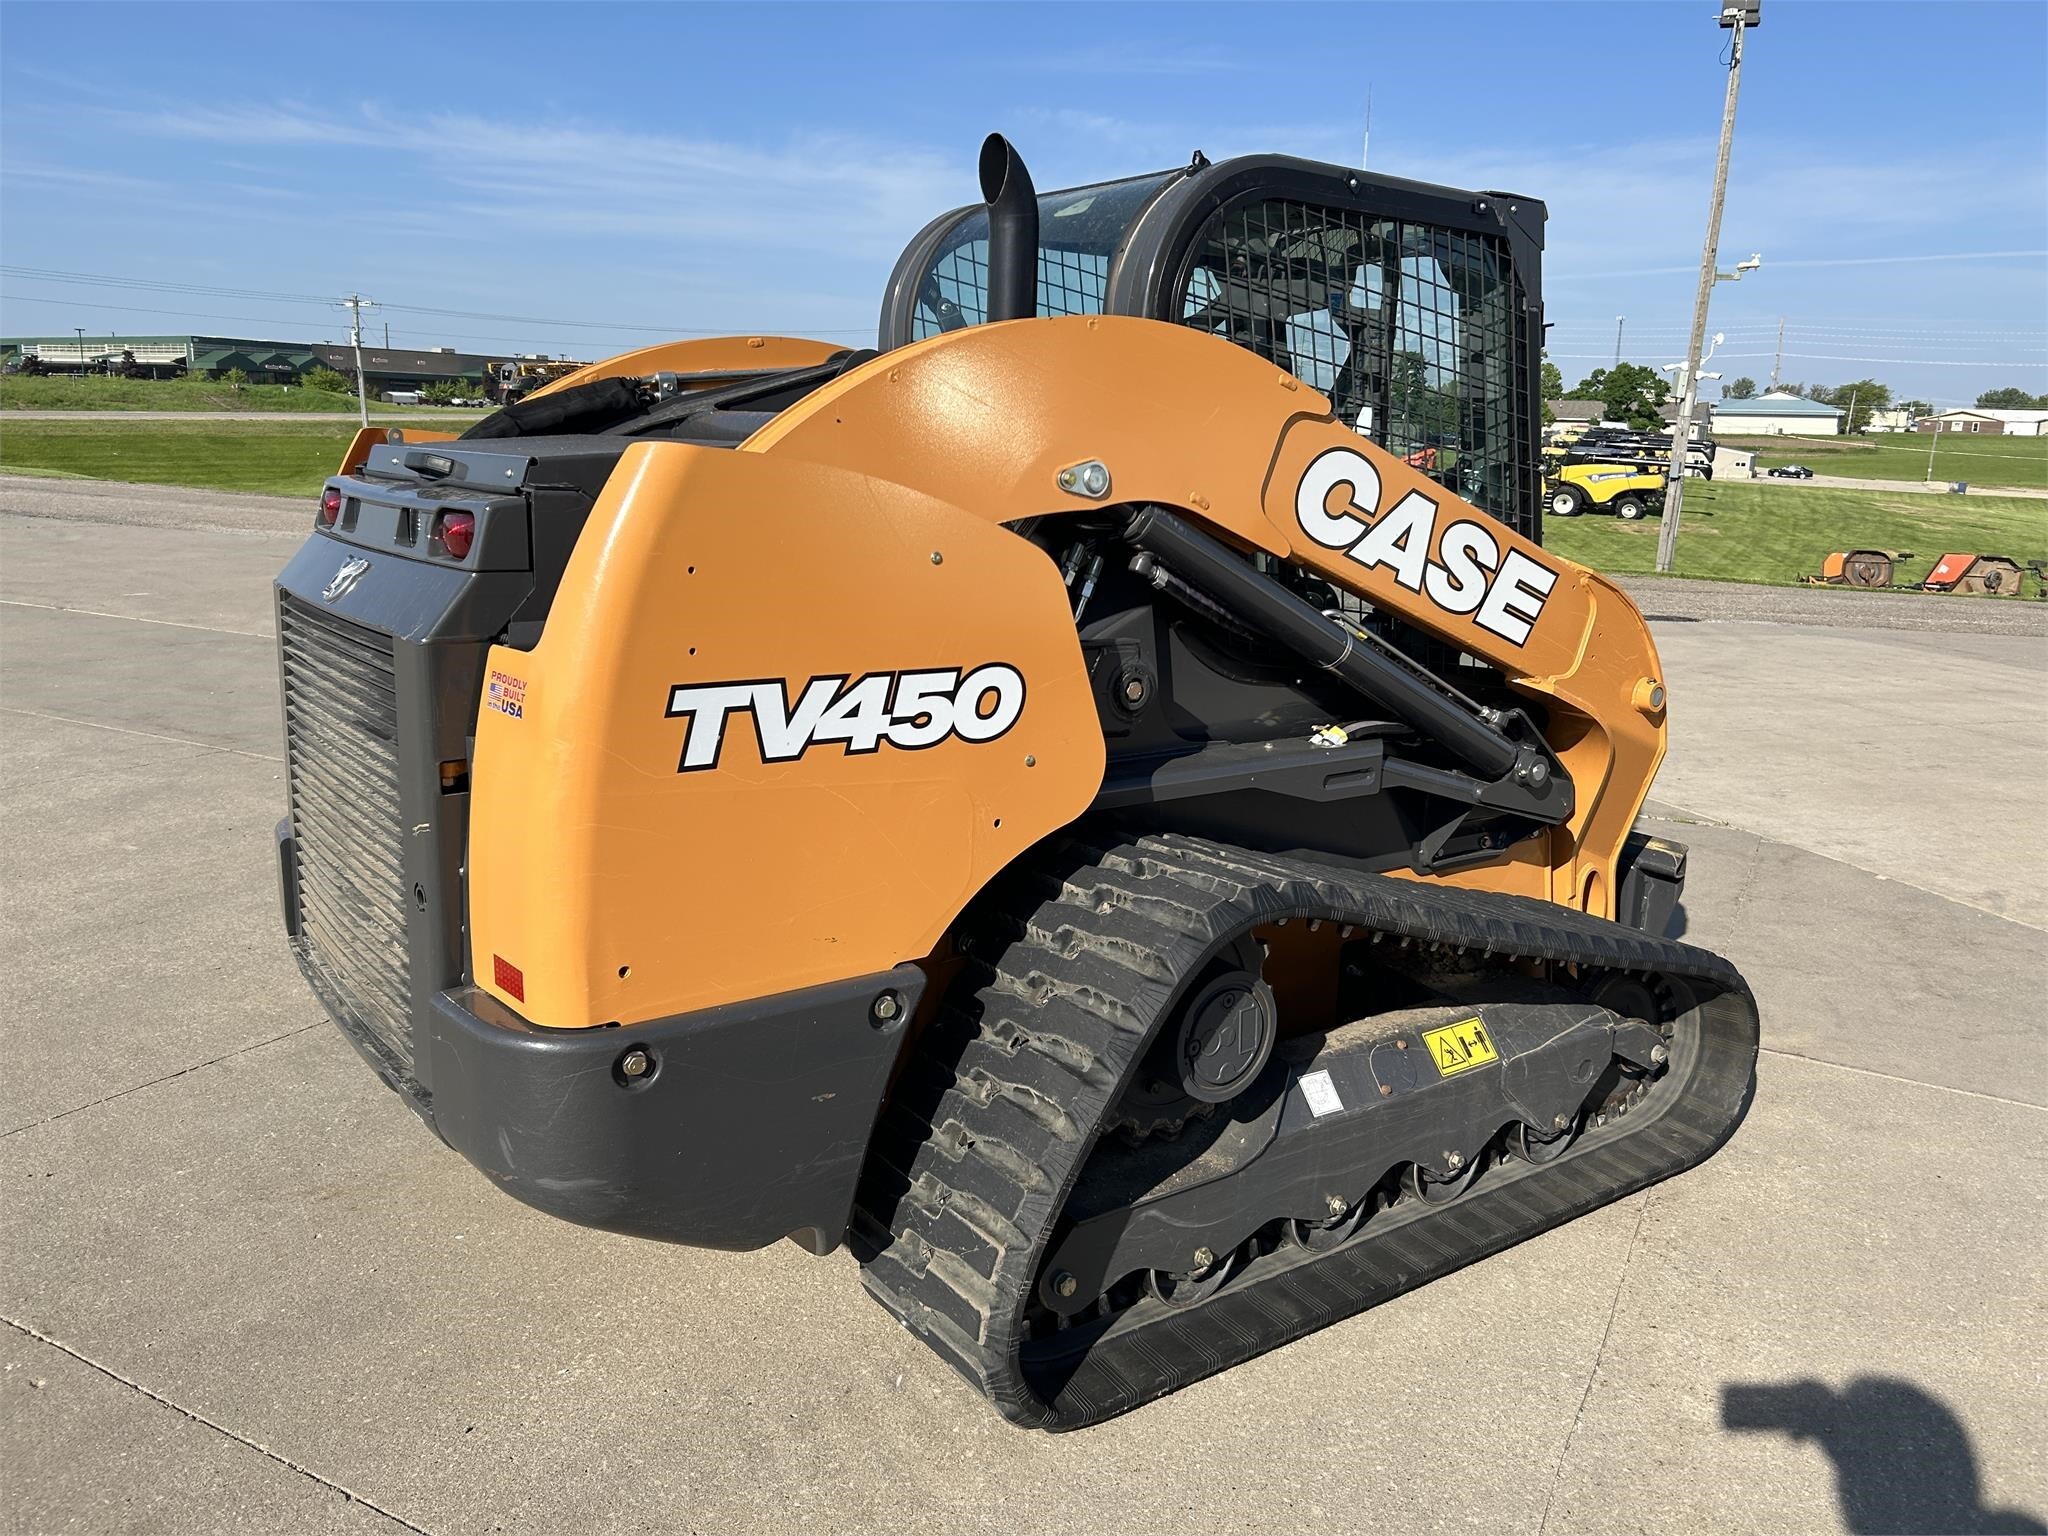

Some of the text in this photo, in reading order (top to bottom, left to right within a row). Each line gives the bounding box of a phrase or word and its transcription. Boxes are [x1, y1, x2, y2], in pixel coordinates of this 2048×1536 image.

[1295, 446, 1560, 648] CASE
[491, 670, 528, 690] PROUDLY
[503, 687, 526, 703] BUILT
[501, 699, 523, 719] USA
[664, 661, 1027, 773] TV450
